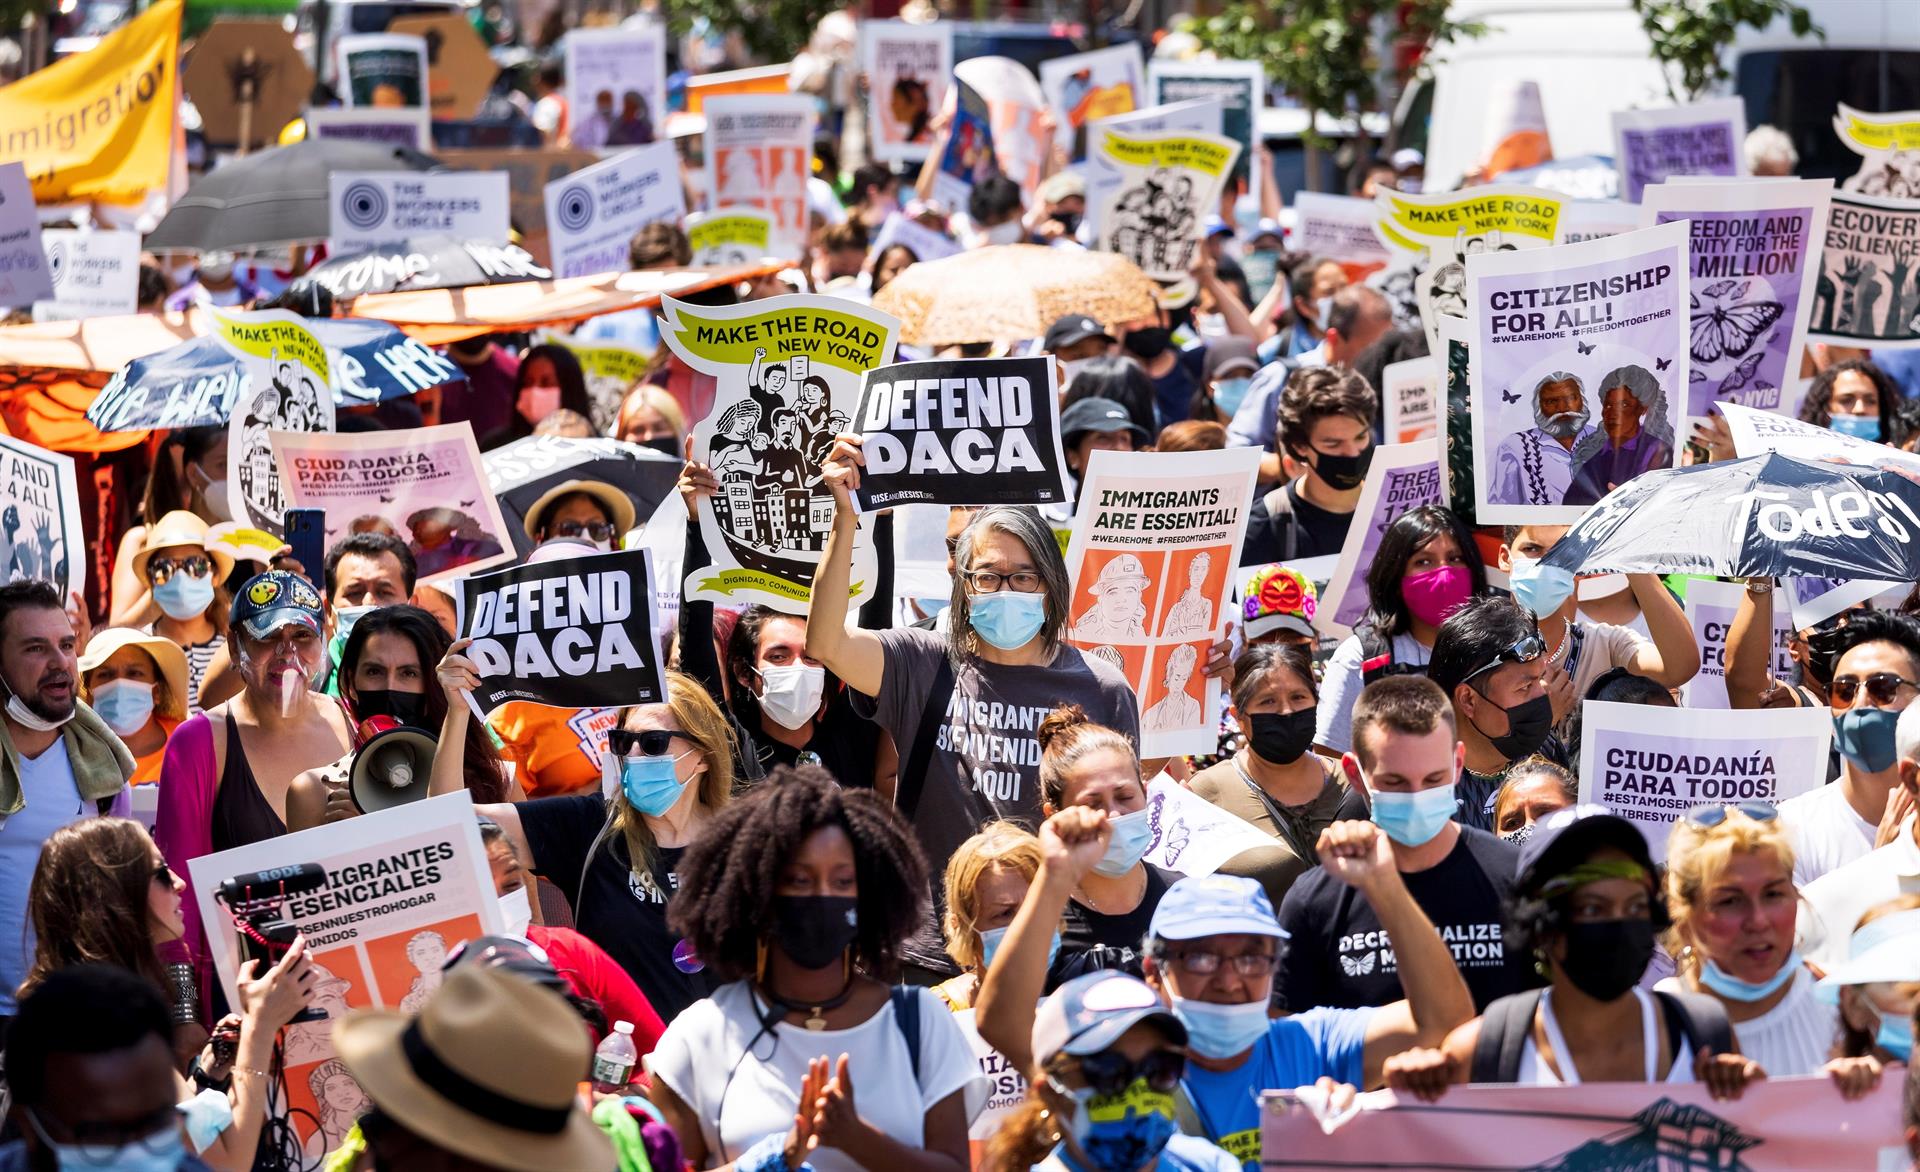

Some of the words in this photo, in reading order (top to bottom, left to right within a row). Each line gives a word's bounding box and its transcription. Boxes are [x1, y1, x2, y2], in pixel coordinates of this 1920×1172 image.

[0, 60, 164, 151] migratio
[1409, 208, 1459, 223] MAKE
[1463, 201, 1497, 216] THE
[1502, 201, 1555, 219] ROAD
[1475, 217, 1508, 230] NEW
[1514, 217, 1551, 233] YORK
[1830, 207, 1920, 237] ECOVER
[1691, 219, 1757, 239] EEDOM
[1763, 216, 1803, 236] AND
[1689, 237, 1730, 254] NITY
[1735, 236, 1766, 252] FOR
[1771, 234, 1800, 250] THE
[1825, 230, 1920, 257] ESILIENCE
[1697, 252, 1797, 278] MILLION
[1490, 265, 1671, 311] CITIZENSHIP
[697, 325, 758, 344] MAKE
[761, 316, 807, 337] THE
[813, 317, 879, 349] ROAD
[1491, 312, 1546, 335] FOR
[1554, 302, 1613, 330] ALL!
[1491, 330, 1566, 344] #WEAREHOME
[1572, 308, 1671, 337] #FREEDOMTOGETHER
[231, 326, 271, 343] MAKE
[272, 327, 296, 341] THE
[778, 338, 821, 353] NEW
[826, 341, 874, 368] YORK
[863, 376, 1033, 431] DEFEND
[294, 451, 430, 471] CIUDADANÍA
[862, 428, 1047, 475] DACA
[11, 458, 49, 488] AND
[297, 471, 354, 482] PARA
[358, 463, 436, 482] TODOS!
[8, 481, 17, 498] 4
[23, 487, 53, 512] ALL
[1099, 488, 1219, 509] IMMIGRANTS
[1386, 481, 1439, 504] DIGNIT
[1094, 512, 1137, 530] ARE
[1141, 507, 1238, 531] ESSENTIAL!
[1091, 534, 1153, 544] #WEAREHOME
[1157, 532, 1227, 544] #FREEDOMTOGETHER
[723, 575, 766, 586] DIGNIDAD,
[768, 580, 811, 598] COMUNIDA
[469, 570, 631, 639] DEFEND
[466, 623, 645, 679] DACA
[936, 724, 1043, 766] BIENVENID
[1606, 749, 1775, 776] CIUDADANÍA
[972, 766, 1021, 801] AQUI
[1604, 770, 1677, 796] PARA
[1686, 778, 1777, 798] TODOS!
[1610, 808, 1684, 823] LIBRESYU
[284, 841, 454, 901] IGRANTES
[290, 865, 442, 920] ESENCIALES
[299, 892, 436, 935] OSENNUESTROHOGAR
[306, 928, 358, 950] YUNIDOS
